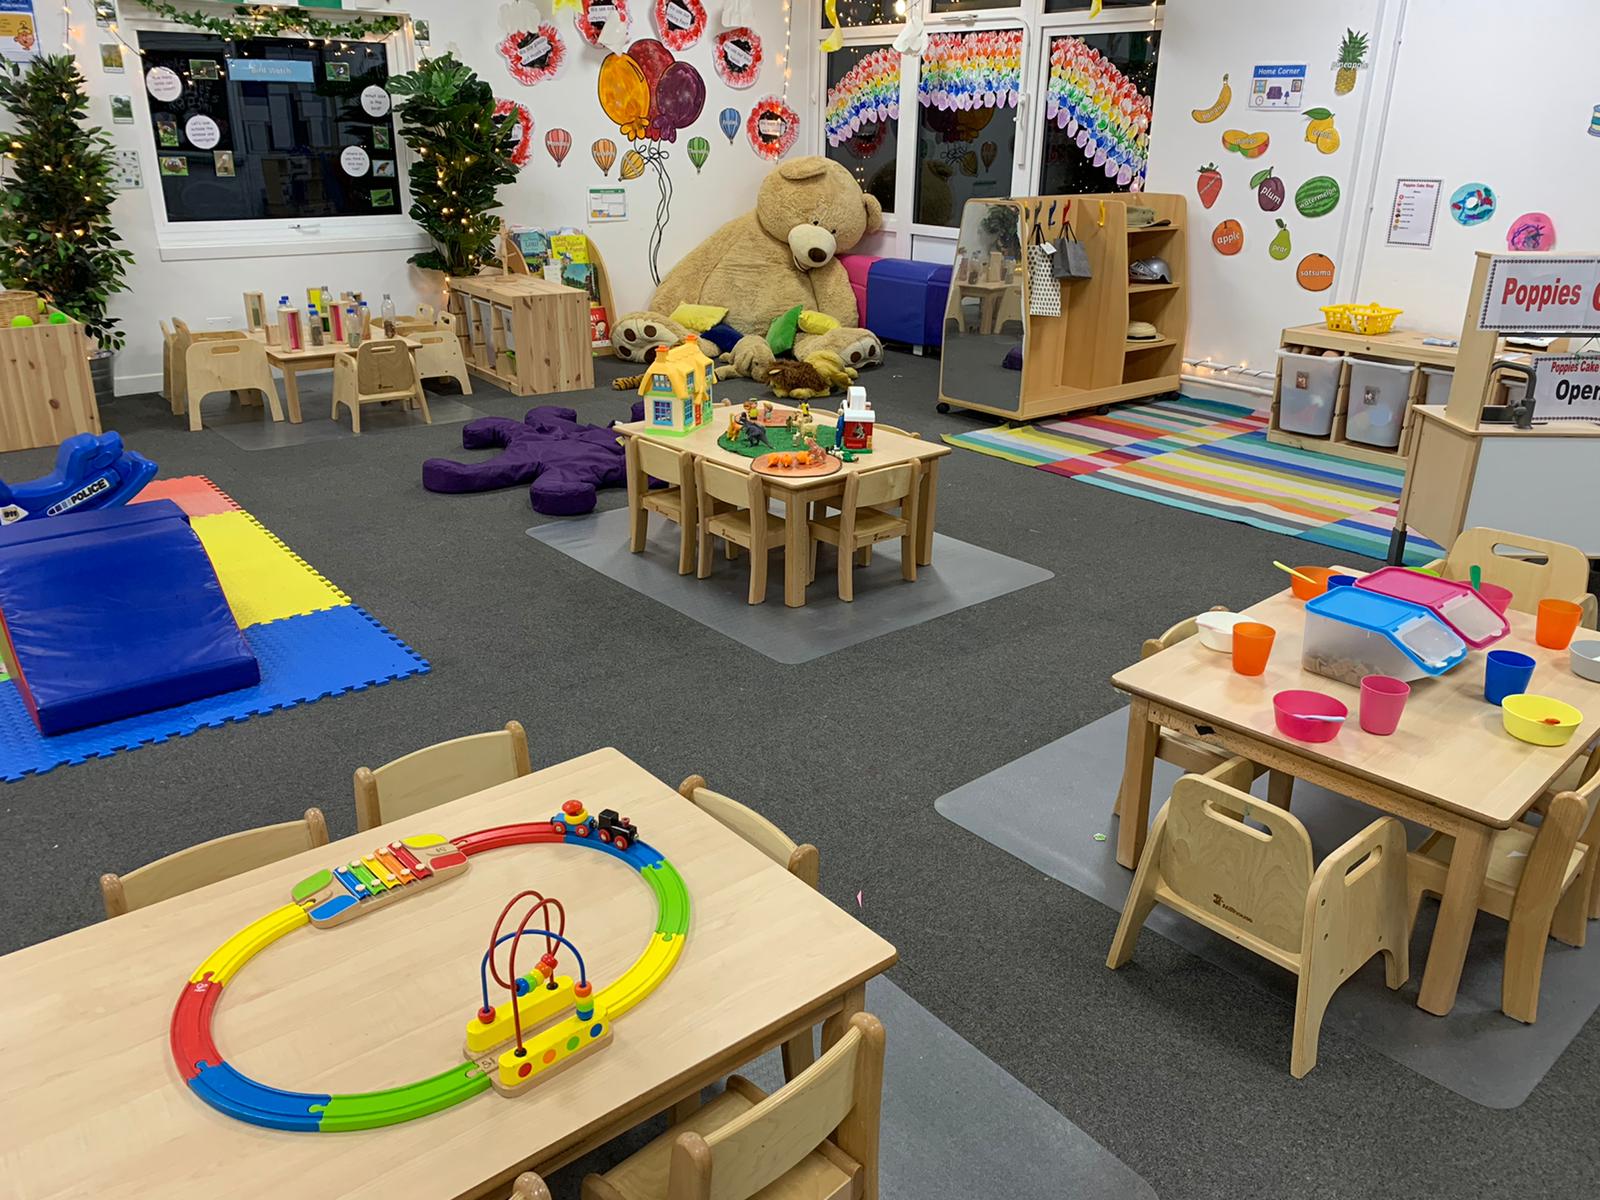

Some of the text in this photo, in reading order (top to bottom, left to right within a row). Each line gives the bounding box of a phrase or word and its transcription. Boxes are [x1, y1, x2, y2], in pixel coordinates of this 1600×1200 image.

[1257, 66, 1301, 75] Home Corner
[1330, 60, 1369, 71] pineapple
[1202, 101, 1226, 120] banana
[1312, 126, 1332, 139] lemon
[1260, 186, 1281, 205] plum
[1299, 186, 1337, 208] watermelon
[1217, 231, 1241, 245] apple
[1272, 244, 1288, 253] pear
[1300, 268, 1332, 277] satsuma
[1501, 277, 1582, 312] Poppies
[1550, 360, 1600, 375] Poppies Cake
[71, 478, 107, 504] POLICE
